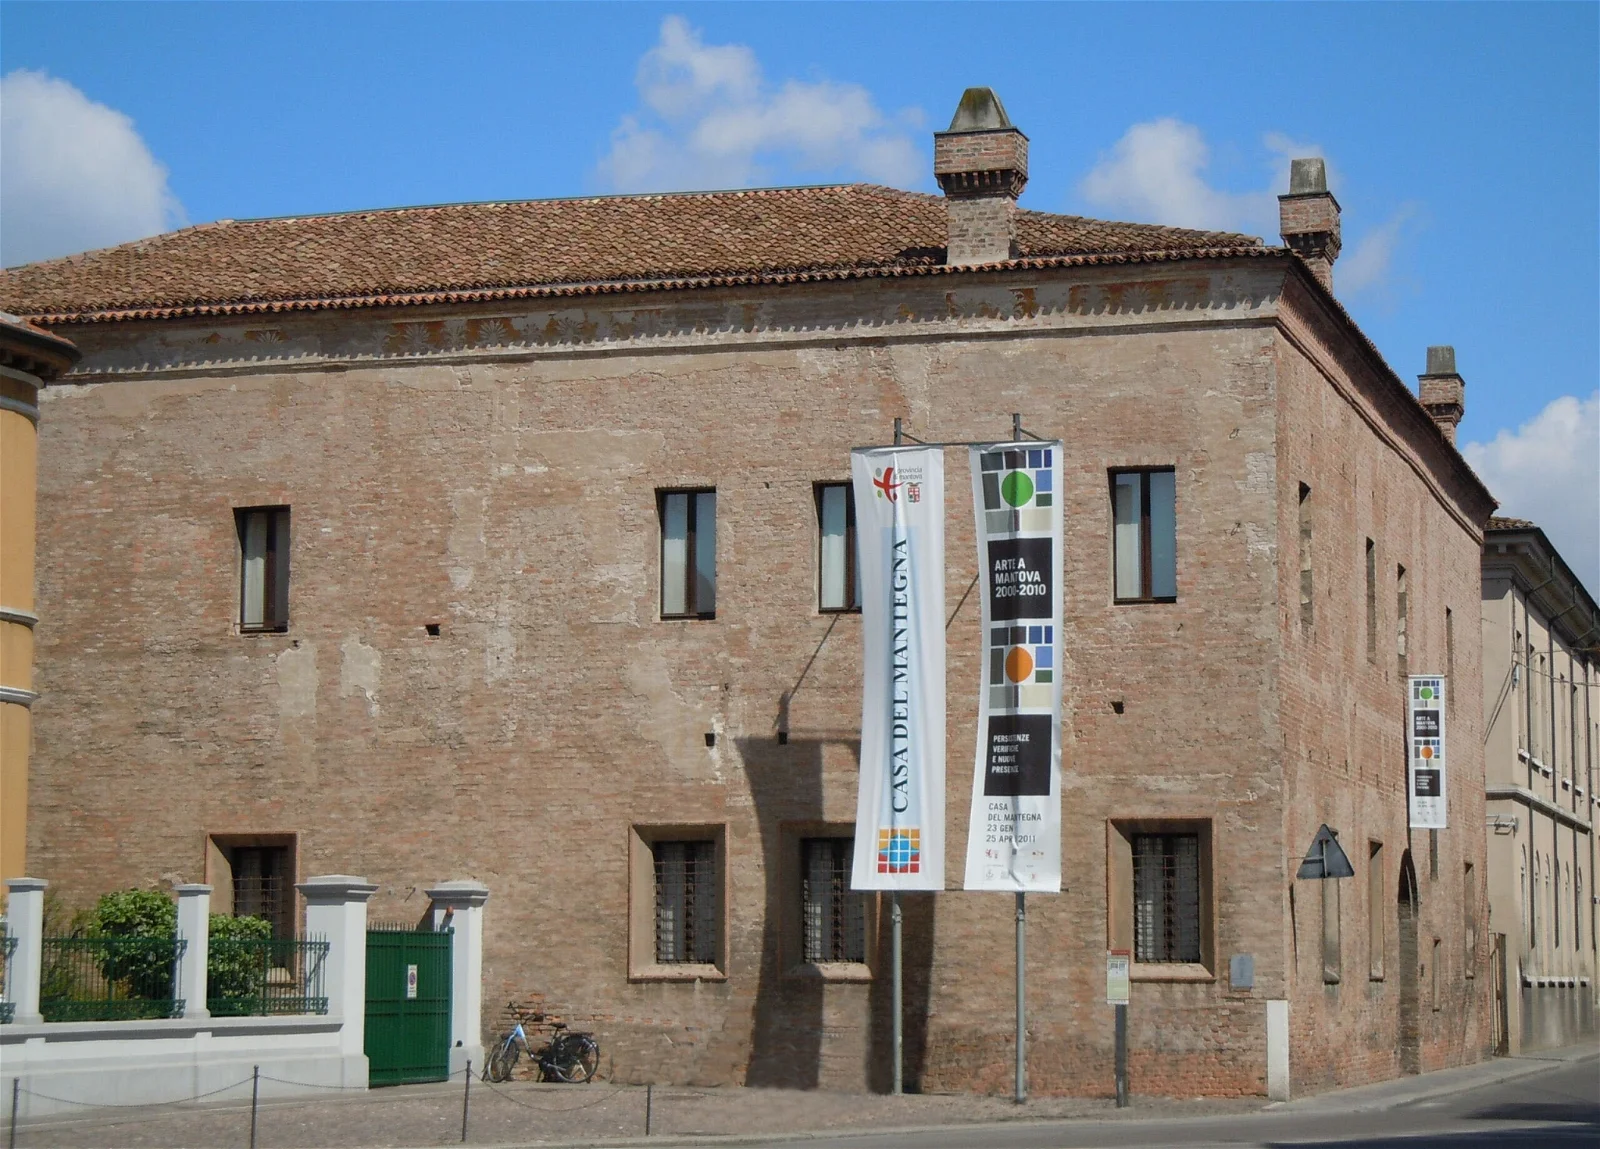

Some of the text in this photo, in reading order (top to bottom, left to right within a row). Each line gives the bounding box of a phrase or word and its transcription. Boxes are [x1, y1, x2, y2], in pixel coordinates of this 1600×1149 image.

[995, 557, 1026, 571] ARTE A
[995, 570, 1041, 584] MANTOVA
[995, 583, 1047, 598] 2000-2010
[892, 539, 909, 813] CASA DEL MANTEGNA
[992, 755, 997, 763] E
[988, 802, 1008, 811] CASA
[988, 813, 1042, 822] DEL MANTEGNA
[987, 824, 1014, 832] 23 GEN
[986, 834, 1036, 843] 25 APR 2011
